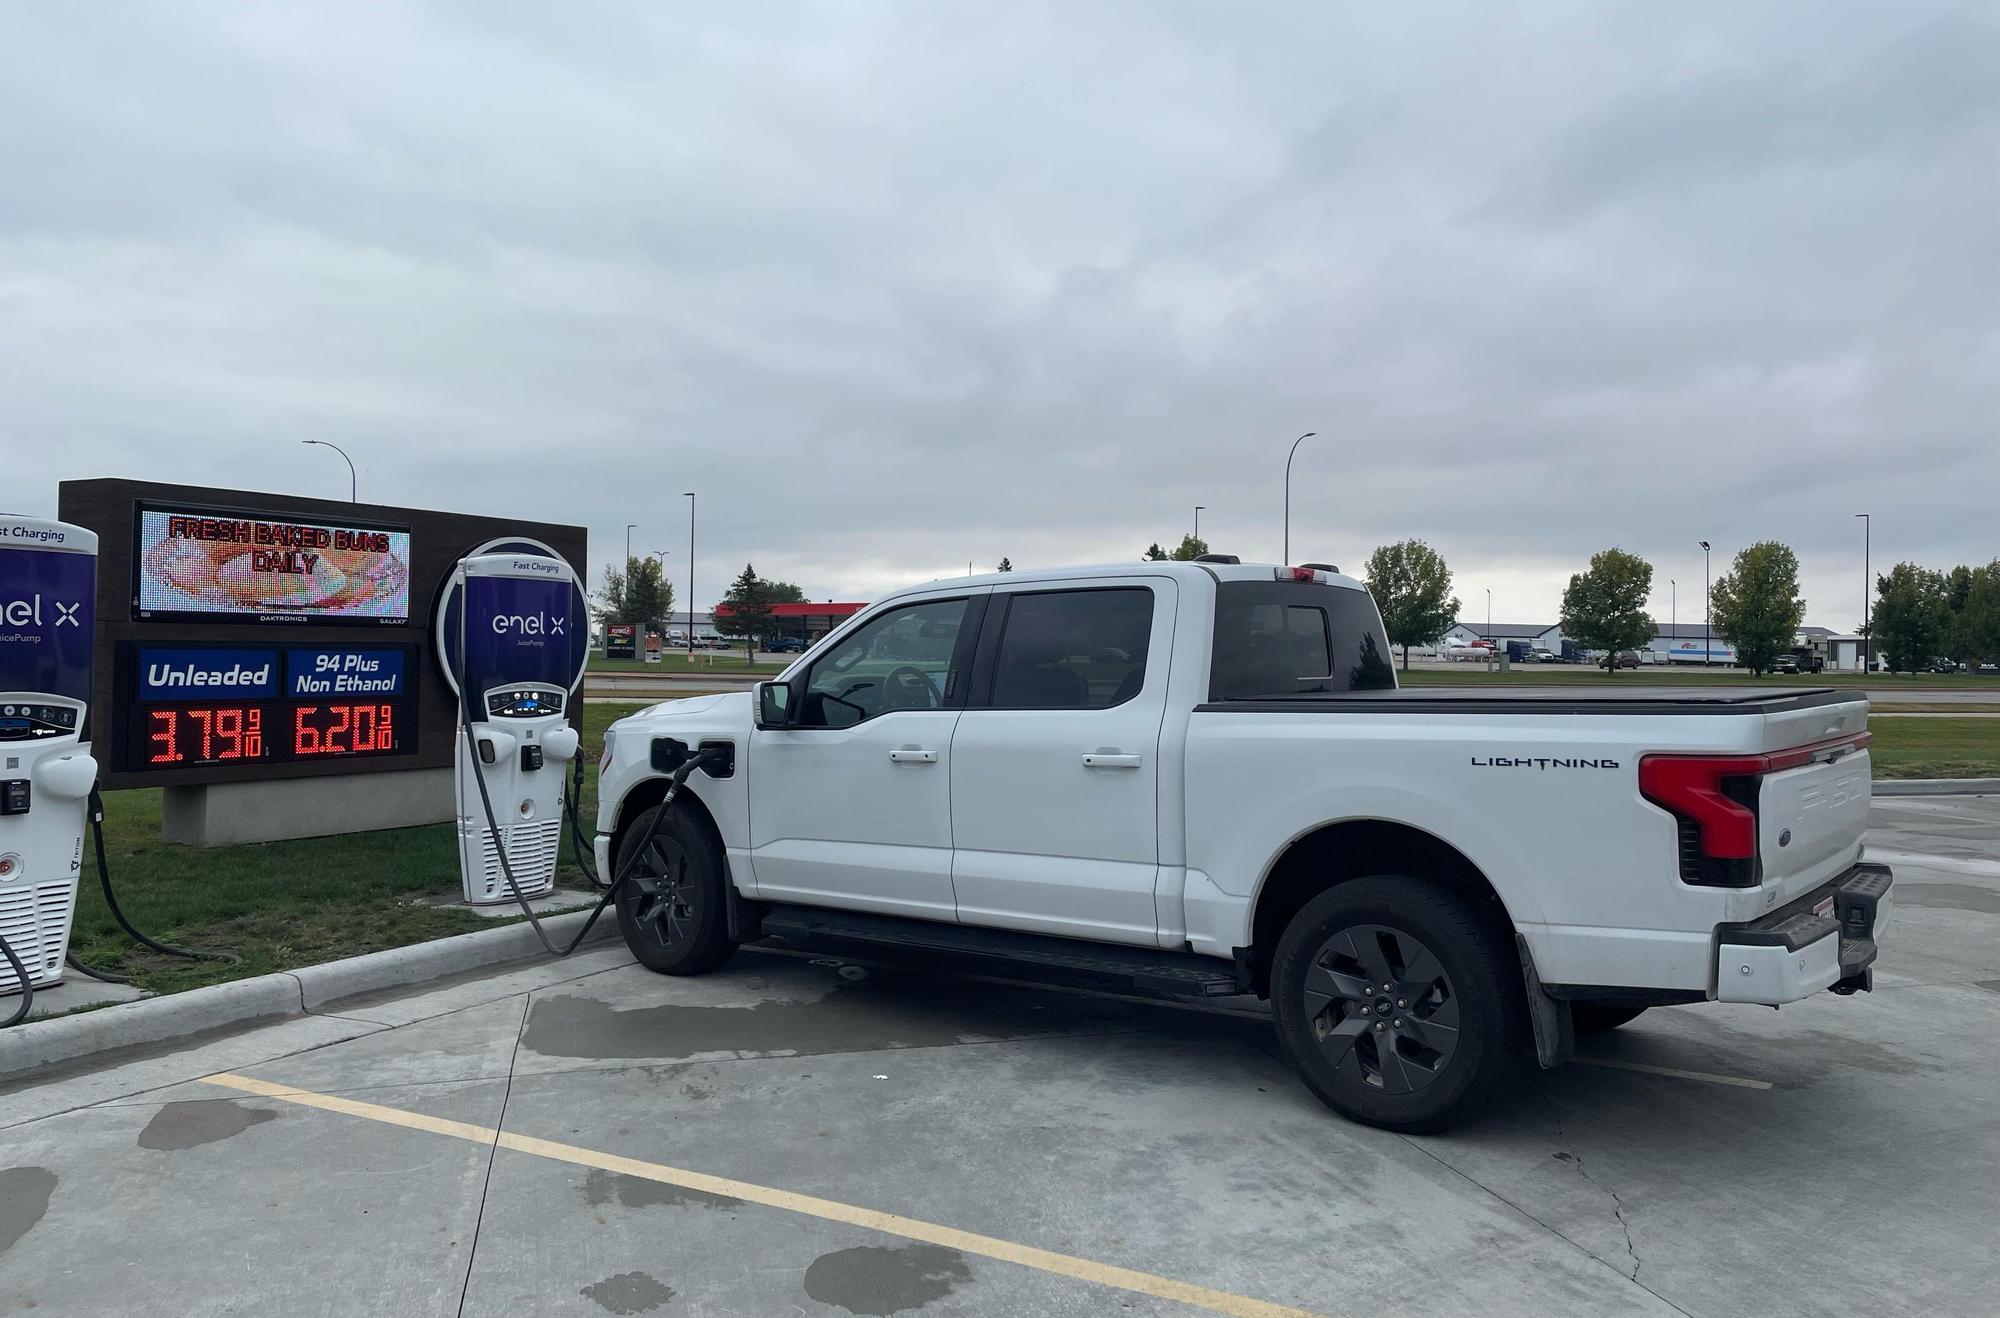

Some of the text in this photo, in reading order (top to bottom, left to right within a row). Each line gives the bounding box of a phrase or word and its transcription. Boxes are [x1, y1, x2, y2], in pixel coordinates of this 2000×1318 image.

[0, 526, 65, 542] t Charging
[169, 515, 389, 553] FRESH BAKED BUNS
[252, 550, 319, 575] DAILY
[513, 561, 559, 573] Fast Charging
[0, 593, 42, 626] el
[492, 610, 545, 635] enel
[315, 654, 380, 673] 94 Plus
[148, 664, 270, 687] Unleaded
[296, 674, 396, 693] Non Ethanol
[1471, 757, 1620, 771] LIGHTNING
